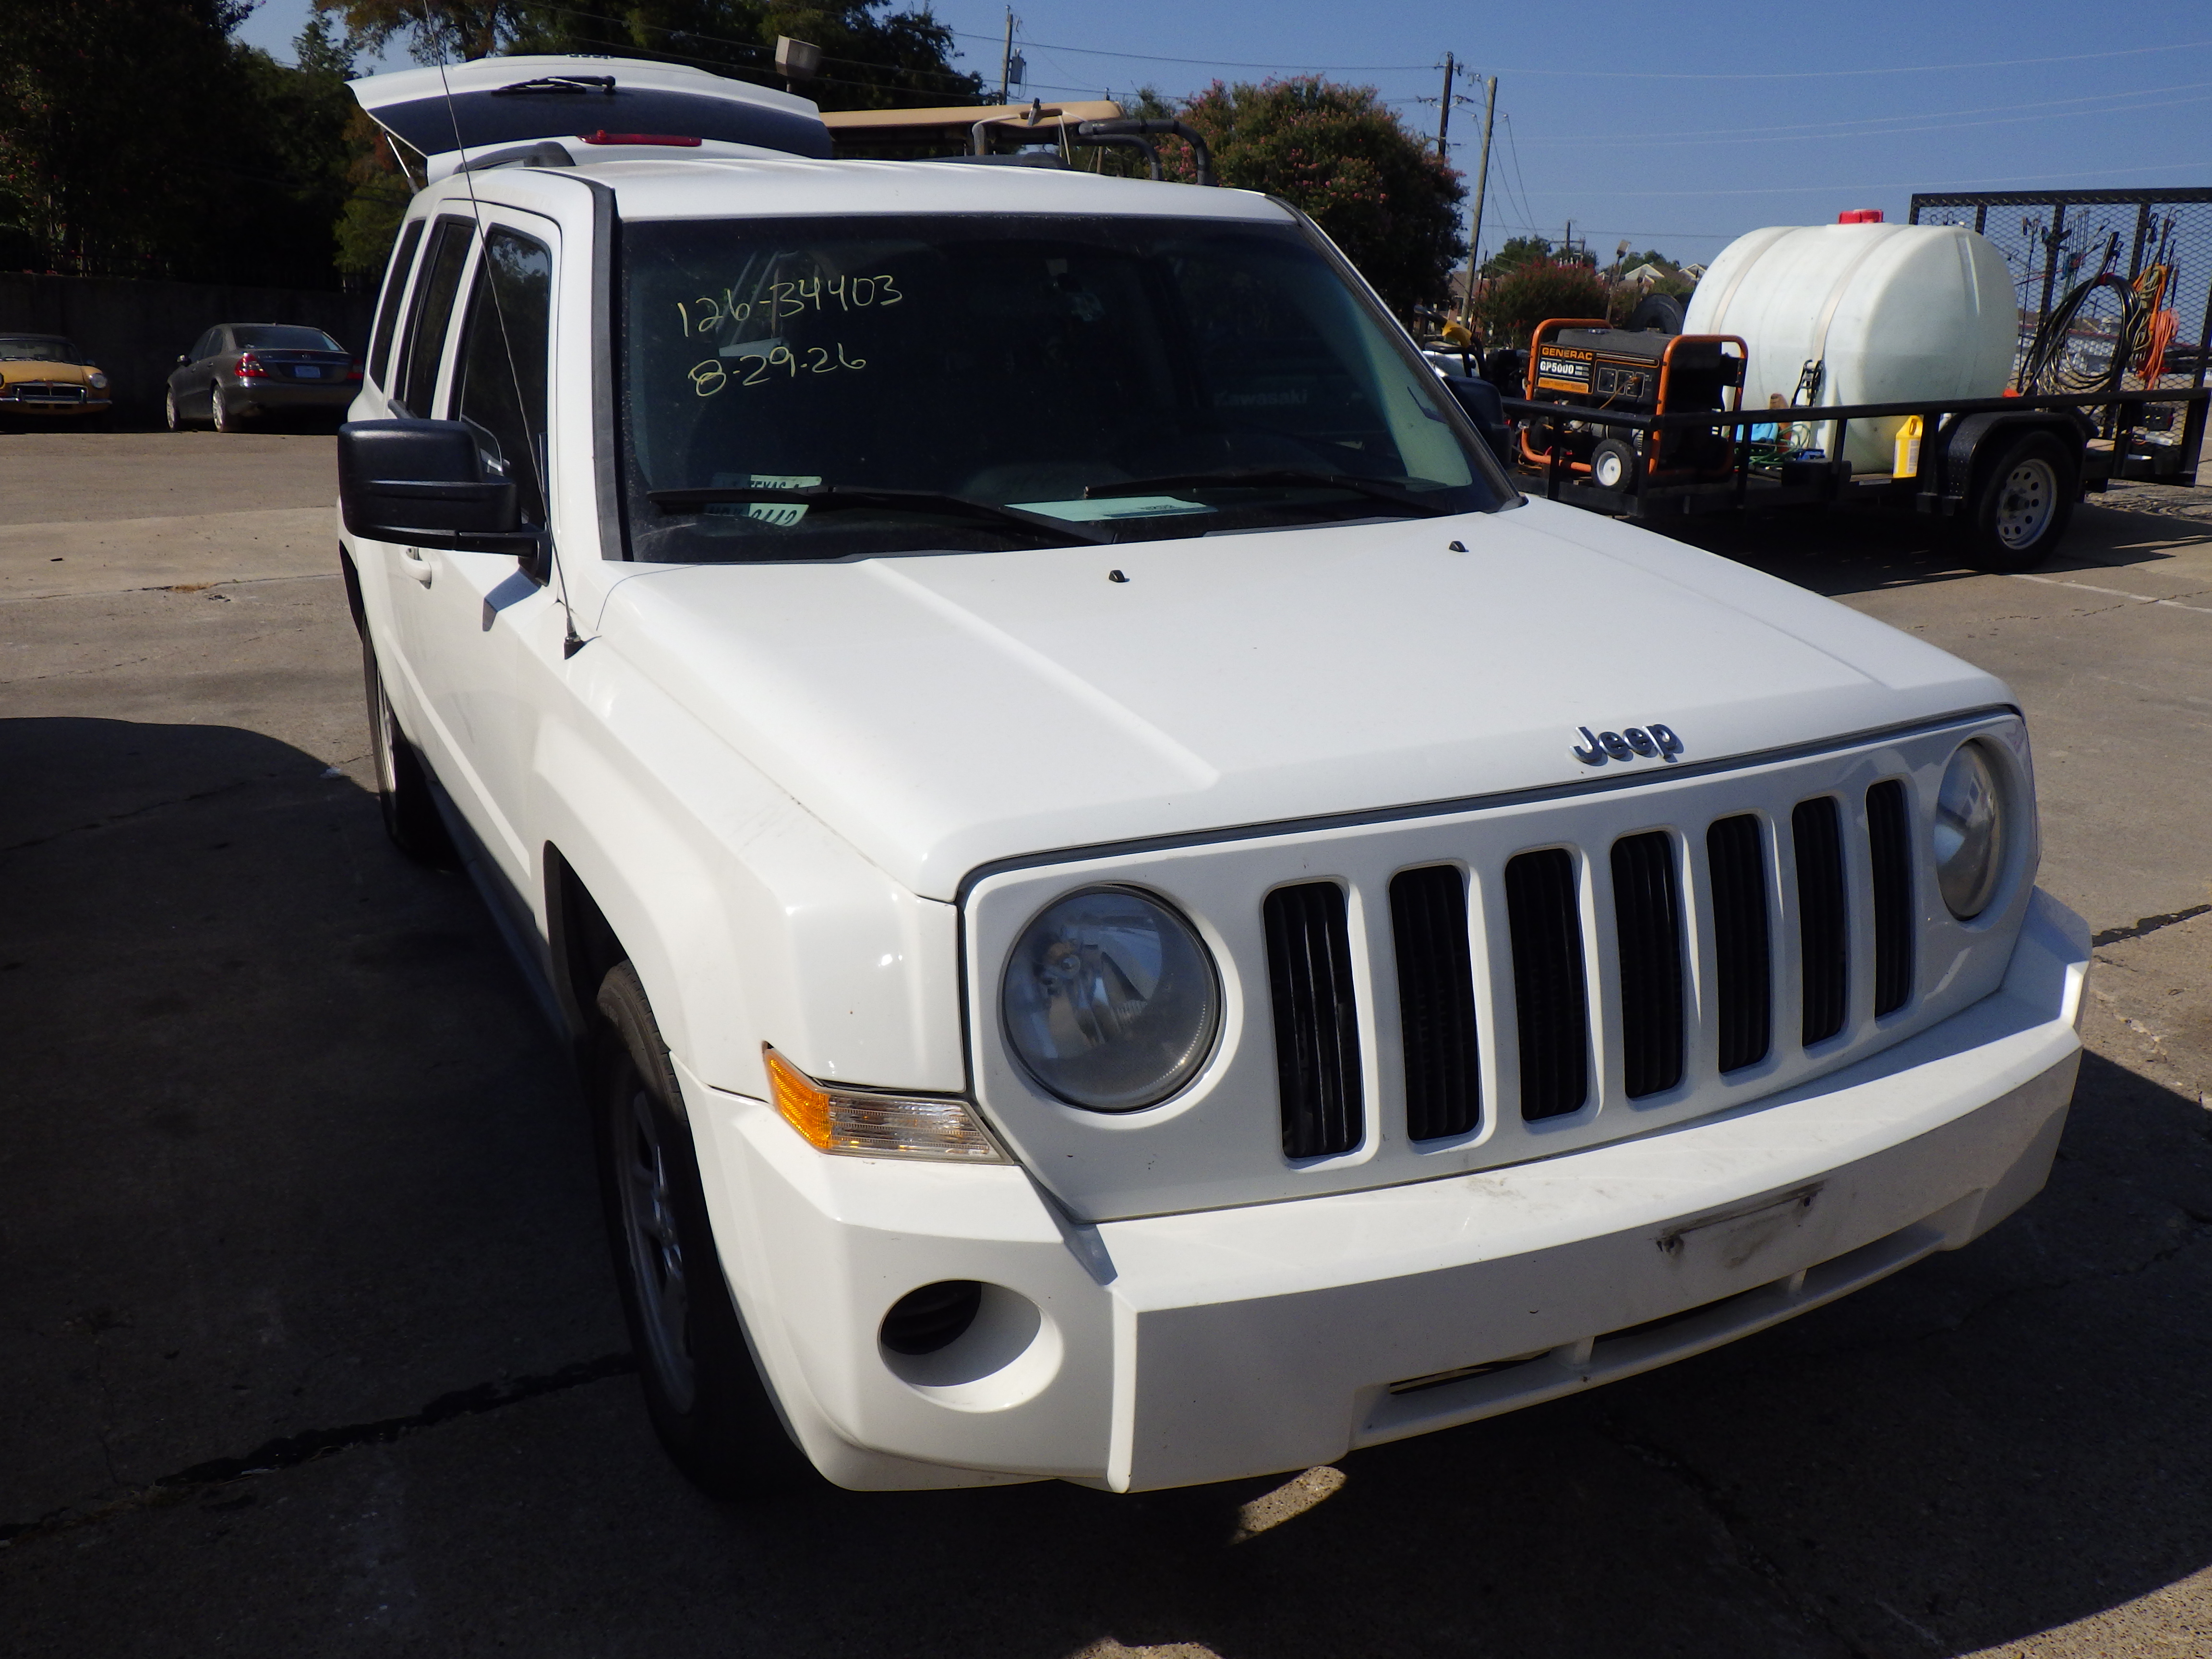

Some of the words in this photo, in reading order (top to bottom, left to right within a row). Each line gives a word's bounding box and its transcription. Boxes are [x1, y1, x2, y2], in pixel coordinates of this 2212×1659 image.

[677, 275, 902, 337] 126-34403
[1542, 347, 1593, 361] GENERAC
[1213, 388, 1308, 407] Kawasaki
[1568, 723, 1681, 765] Jeep
